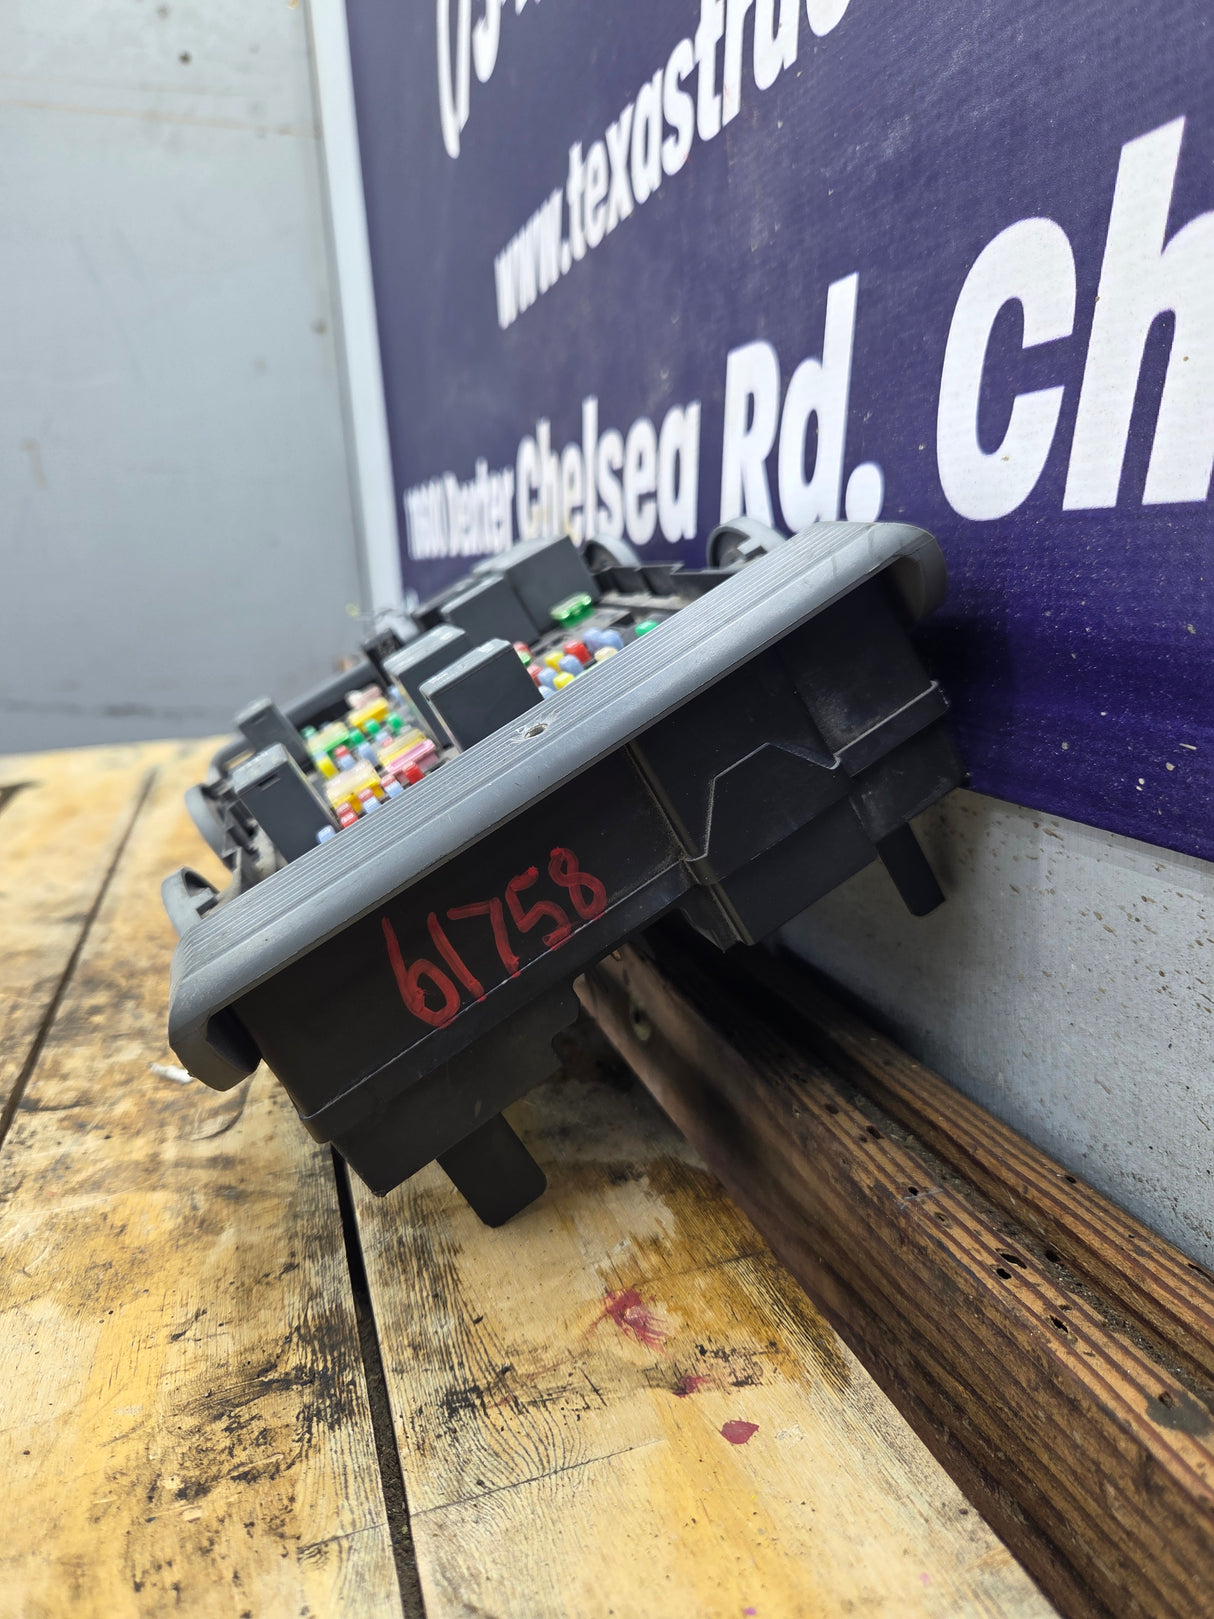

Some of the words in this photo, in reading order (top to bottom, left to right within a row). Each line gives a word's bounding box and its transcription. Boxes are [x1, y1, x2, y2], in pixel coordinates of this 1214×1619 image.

[494, 0, 850, 330] www.texastru
[516, 394, 701, 547] Chelsea
[719, 272, 885, 535] Rd.
[381, 847, 608, 1029] 61758
